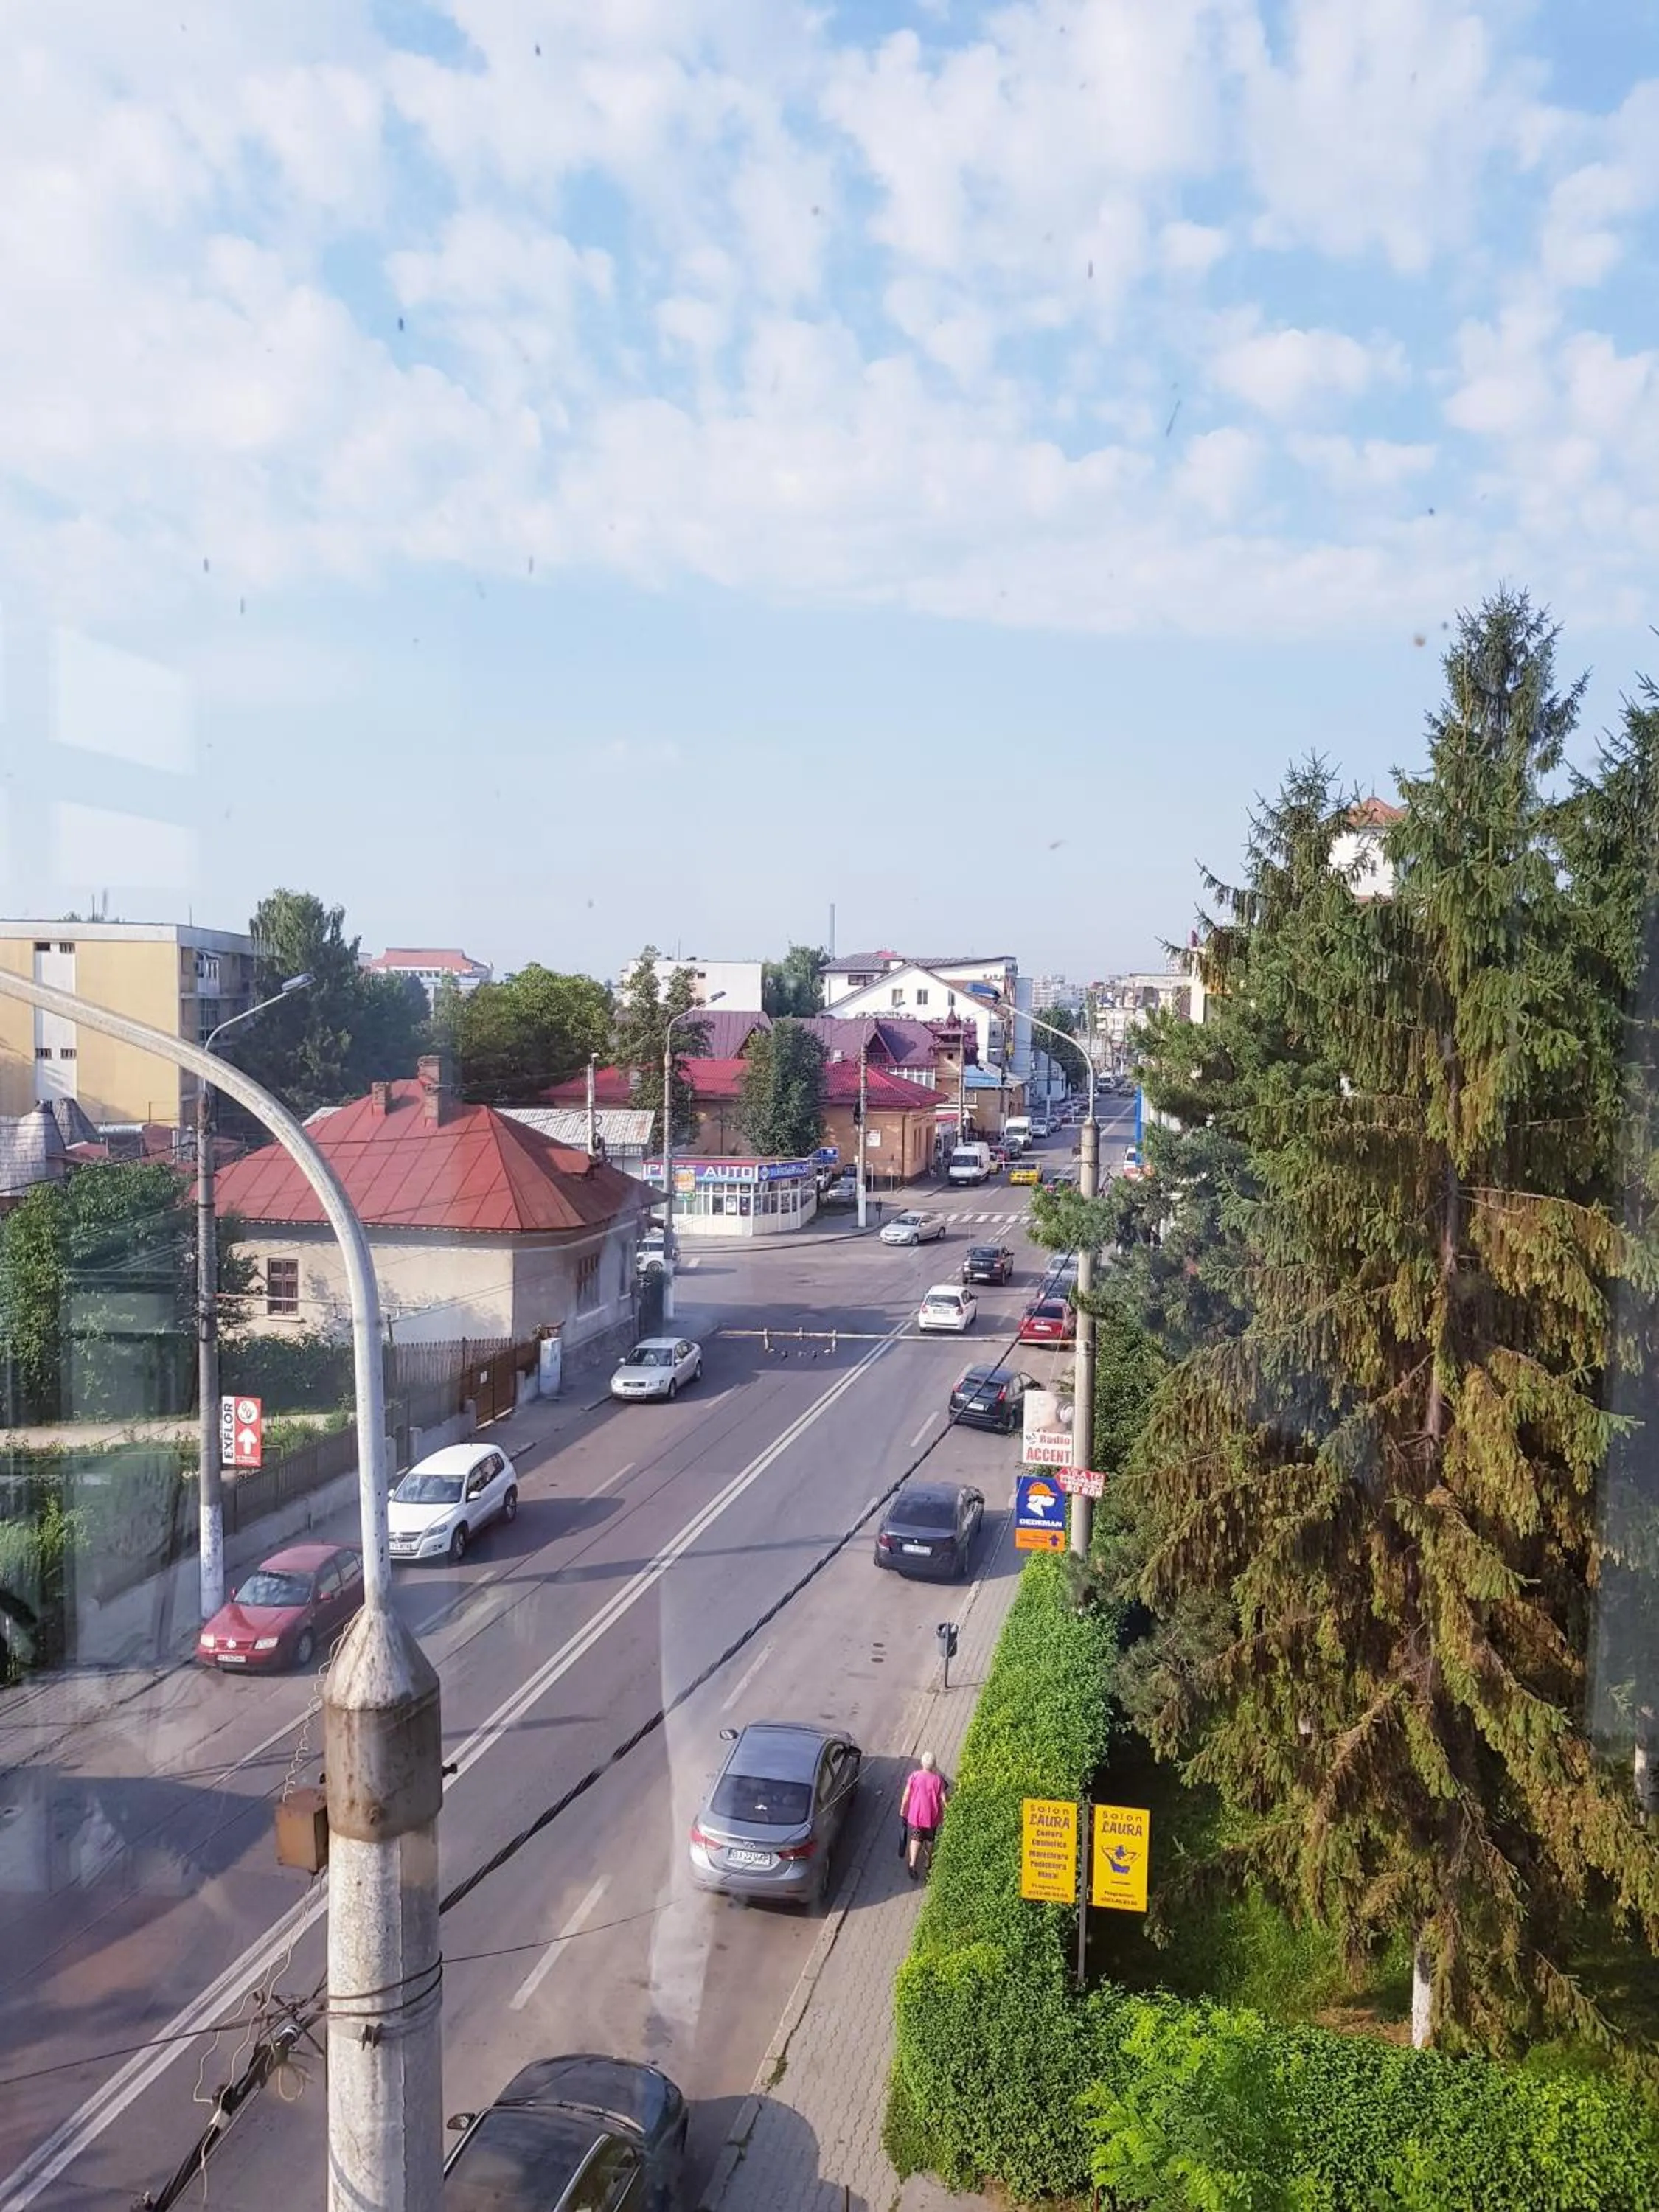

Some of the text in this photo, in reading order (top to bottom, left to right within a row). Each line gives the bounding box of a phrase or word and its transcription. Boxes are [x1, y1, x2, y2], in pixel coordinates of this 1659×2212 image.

[705, 1165, 753, 1178] AUTO
[223, 1403, 234, 1459] EXFLOR
[1039, 1434, 1071, 1445] Radio
[1026, 1447, 1071, 1464] ACCENT
[1019, 1518, 1062, 1528] DEDEMAN
